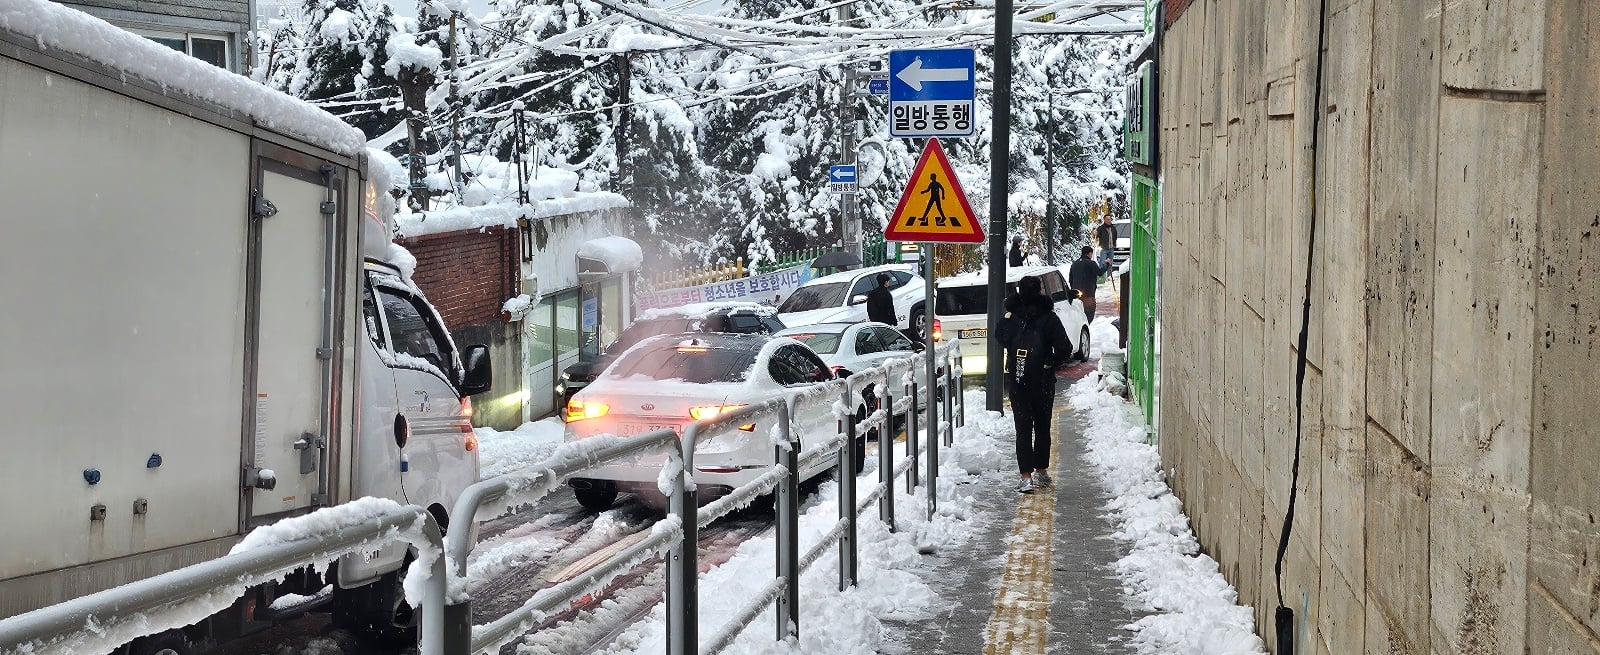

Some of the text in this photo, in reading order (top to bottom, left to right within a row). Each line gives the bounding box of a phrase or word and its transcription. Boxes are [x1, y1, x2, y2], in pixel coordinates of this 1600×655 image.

[894, 104, 970, 130] 일방통행
[832, 183, 856, 191] 일방통행
[704, 282, 746, 302] 청소년을
[750, 270, 801, 294] 보호합시다
